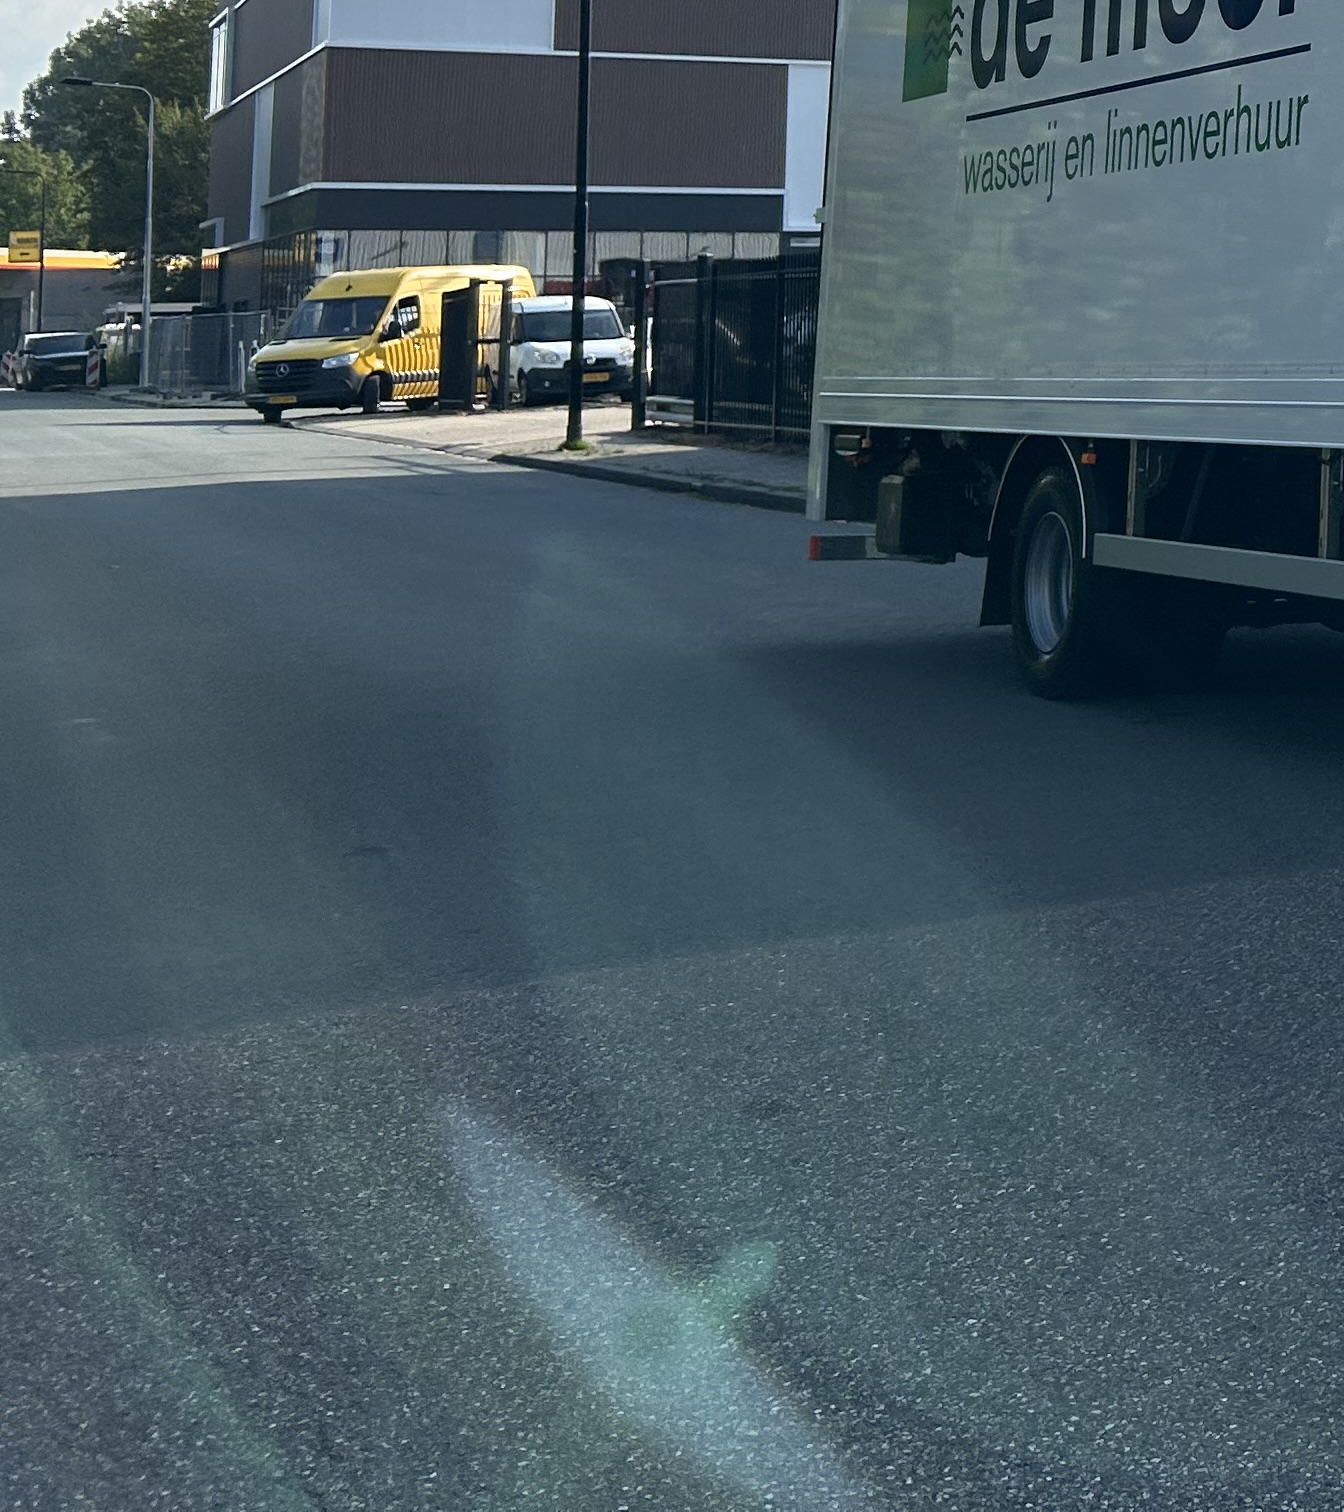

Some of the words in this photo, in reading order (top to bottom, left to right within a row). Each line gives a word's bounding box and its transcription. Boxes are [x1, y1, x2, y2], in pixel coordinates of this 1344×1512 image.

[963, 121, 1056, 202] wasserij
[1065, 130, 1095, 180] en
[1104, 84, 1309, 174] linnenverhuur
